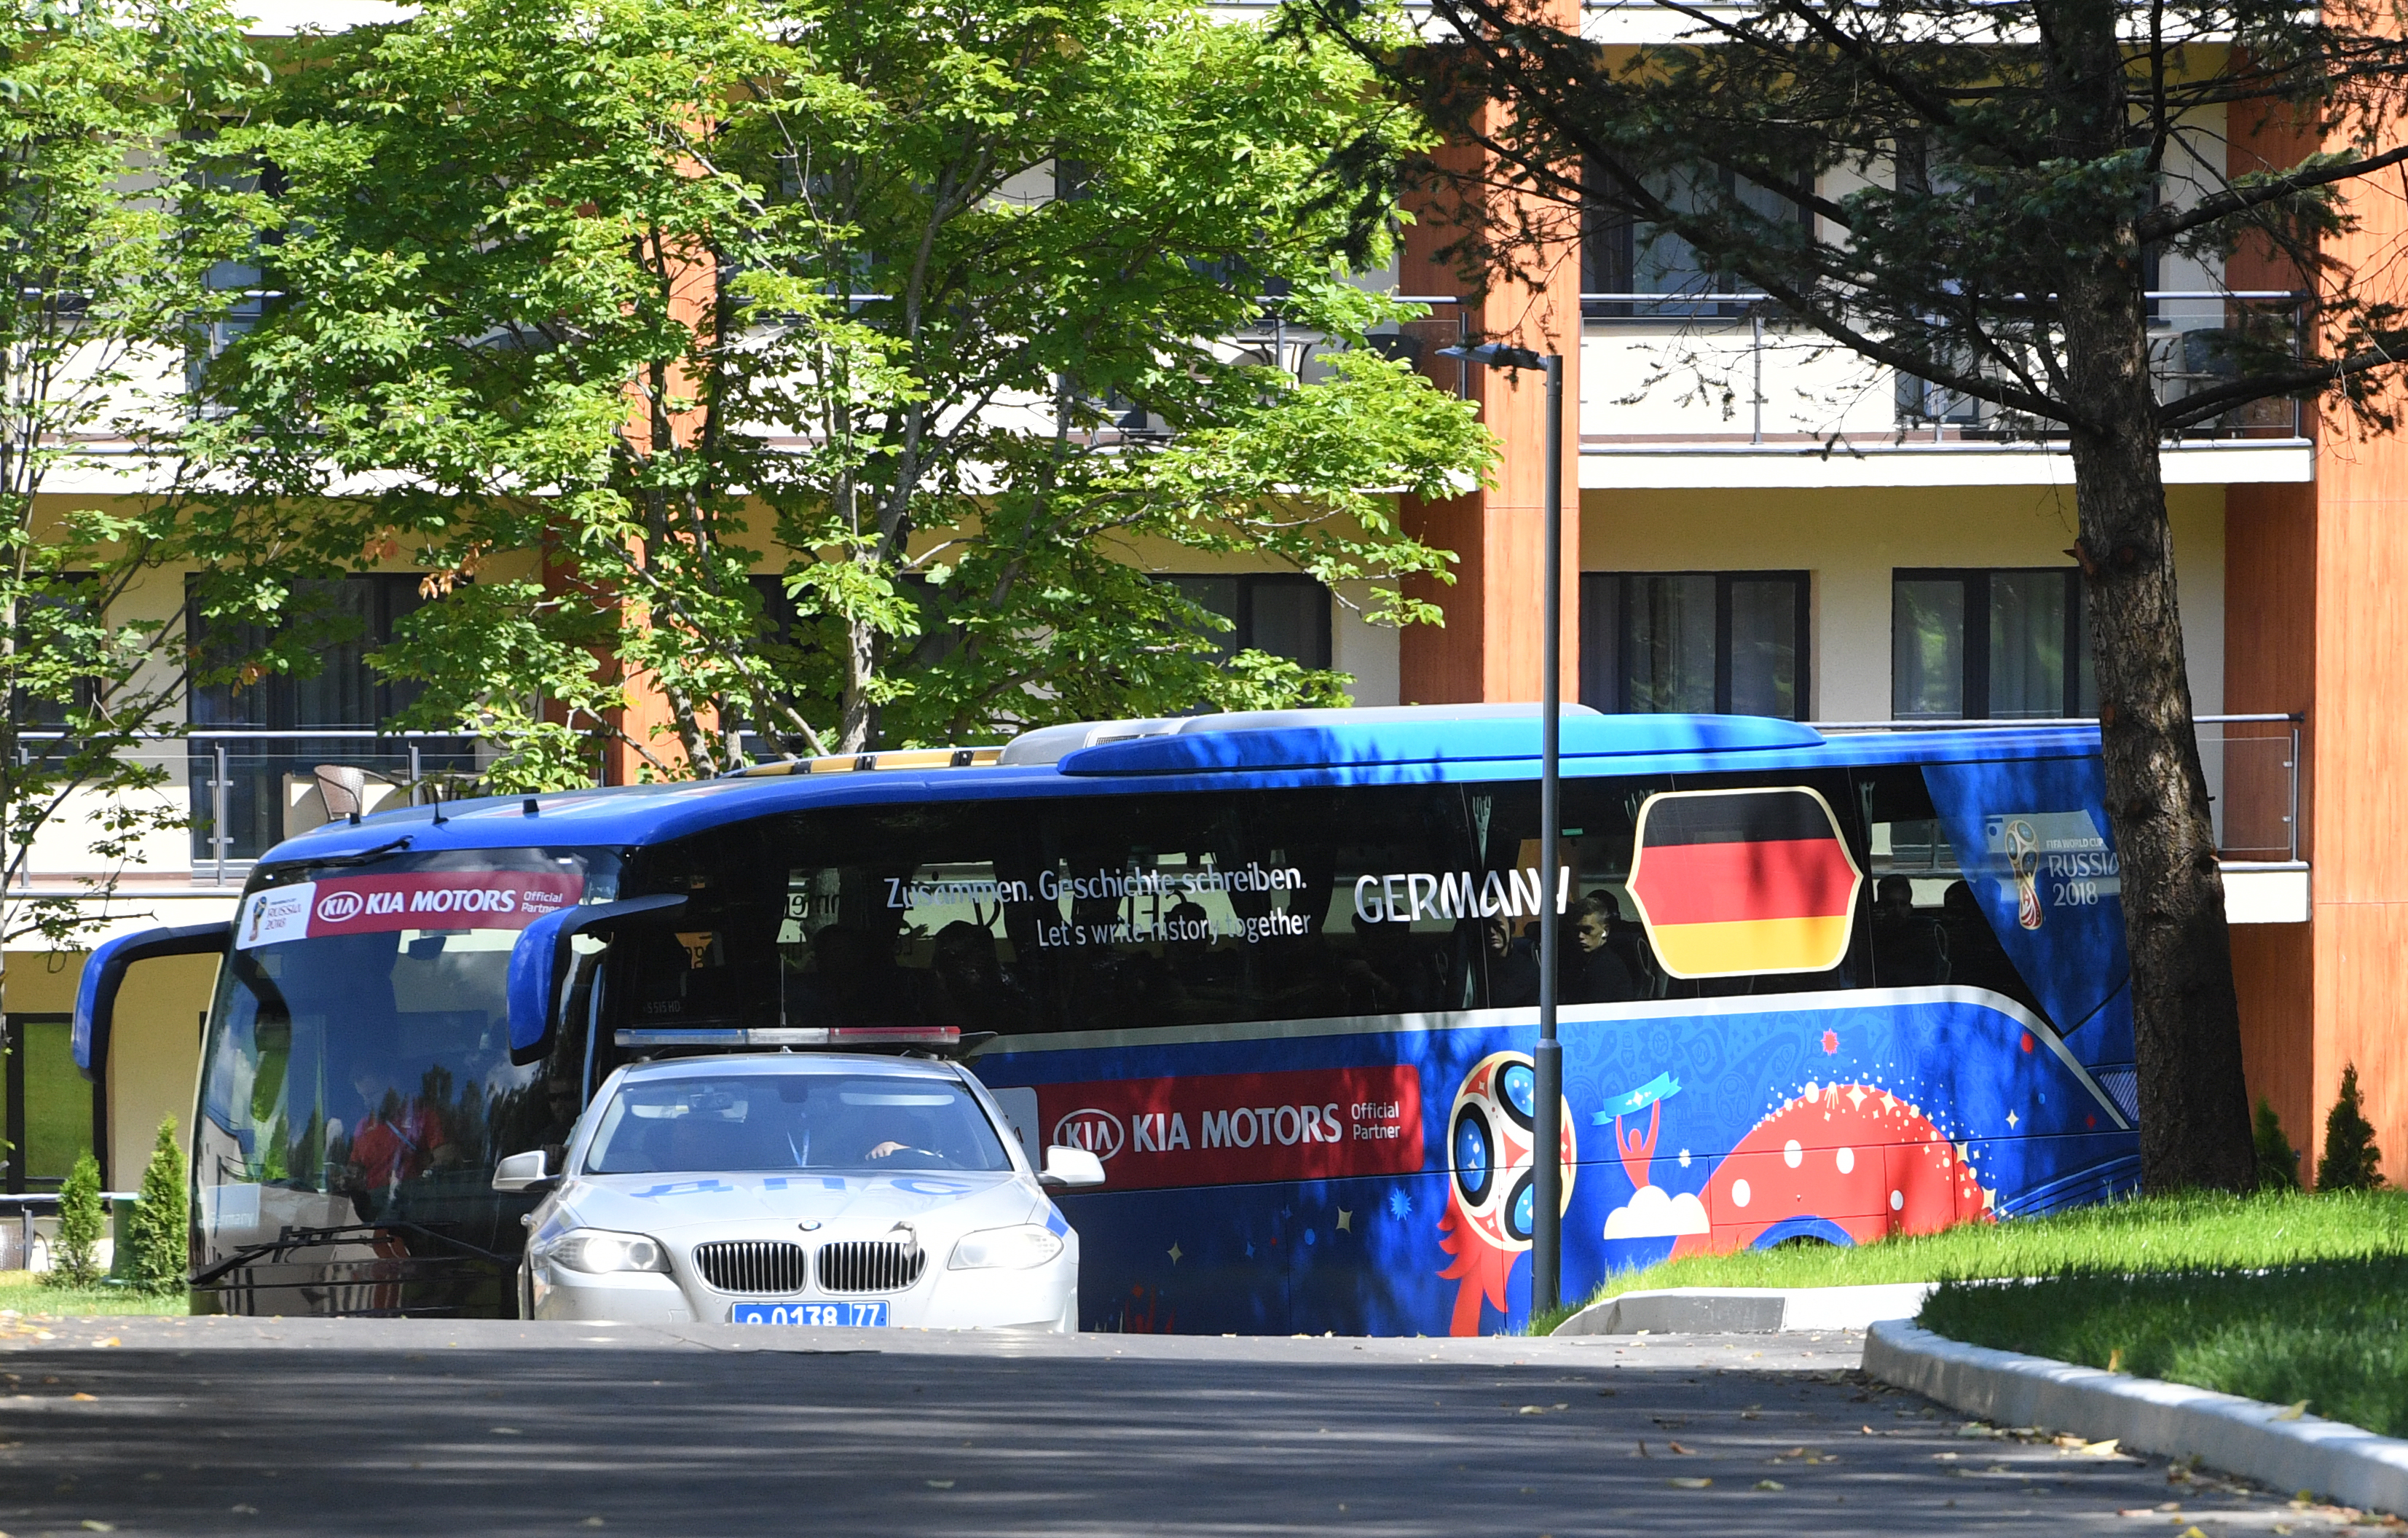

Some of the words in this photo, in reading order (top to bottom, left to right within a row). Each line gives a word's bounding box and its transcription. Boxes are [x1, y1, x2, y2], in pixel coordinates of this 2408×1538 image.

[2048, 852, 2120, 877] RUSSIA
[523, 891, 563, 903] Official
[884, 877, 1034, 909] Zusammen.
[1039, 866, 1176, 901] Geschichte
[1182, 861, 1307, 895] schreiben.
[2053, 882, 2098, 906] 2018
[366, 892, 404, 914] KIA
[409, 889, 516, 912] MOTORS
[1091, 910, 1144, 944] write
[1147, 911, 1219, 946] history
[1225, 906, 1311, 943] together
[1351, 1101, 1399, 1121] Official
[1133, 1112, 1191, 1153] KIA
[1202, 1103, 1342, 1149] MOTORS
[1353, 1123, 1401, 1141] Partner
[629, 1177, 973, 1198] ДПС
[854, 1304, 880, 1327] 77
